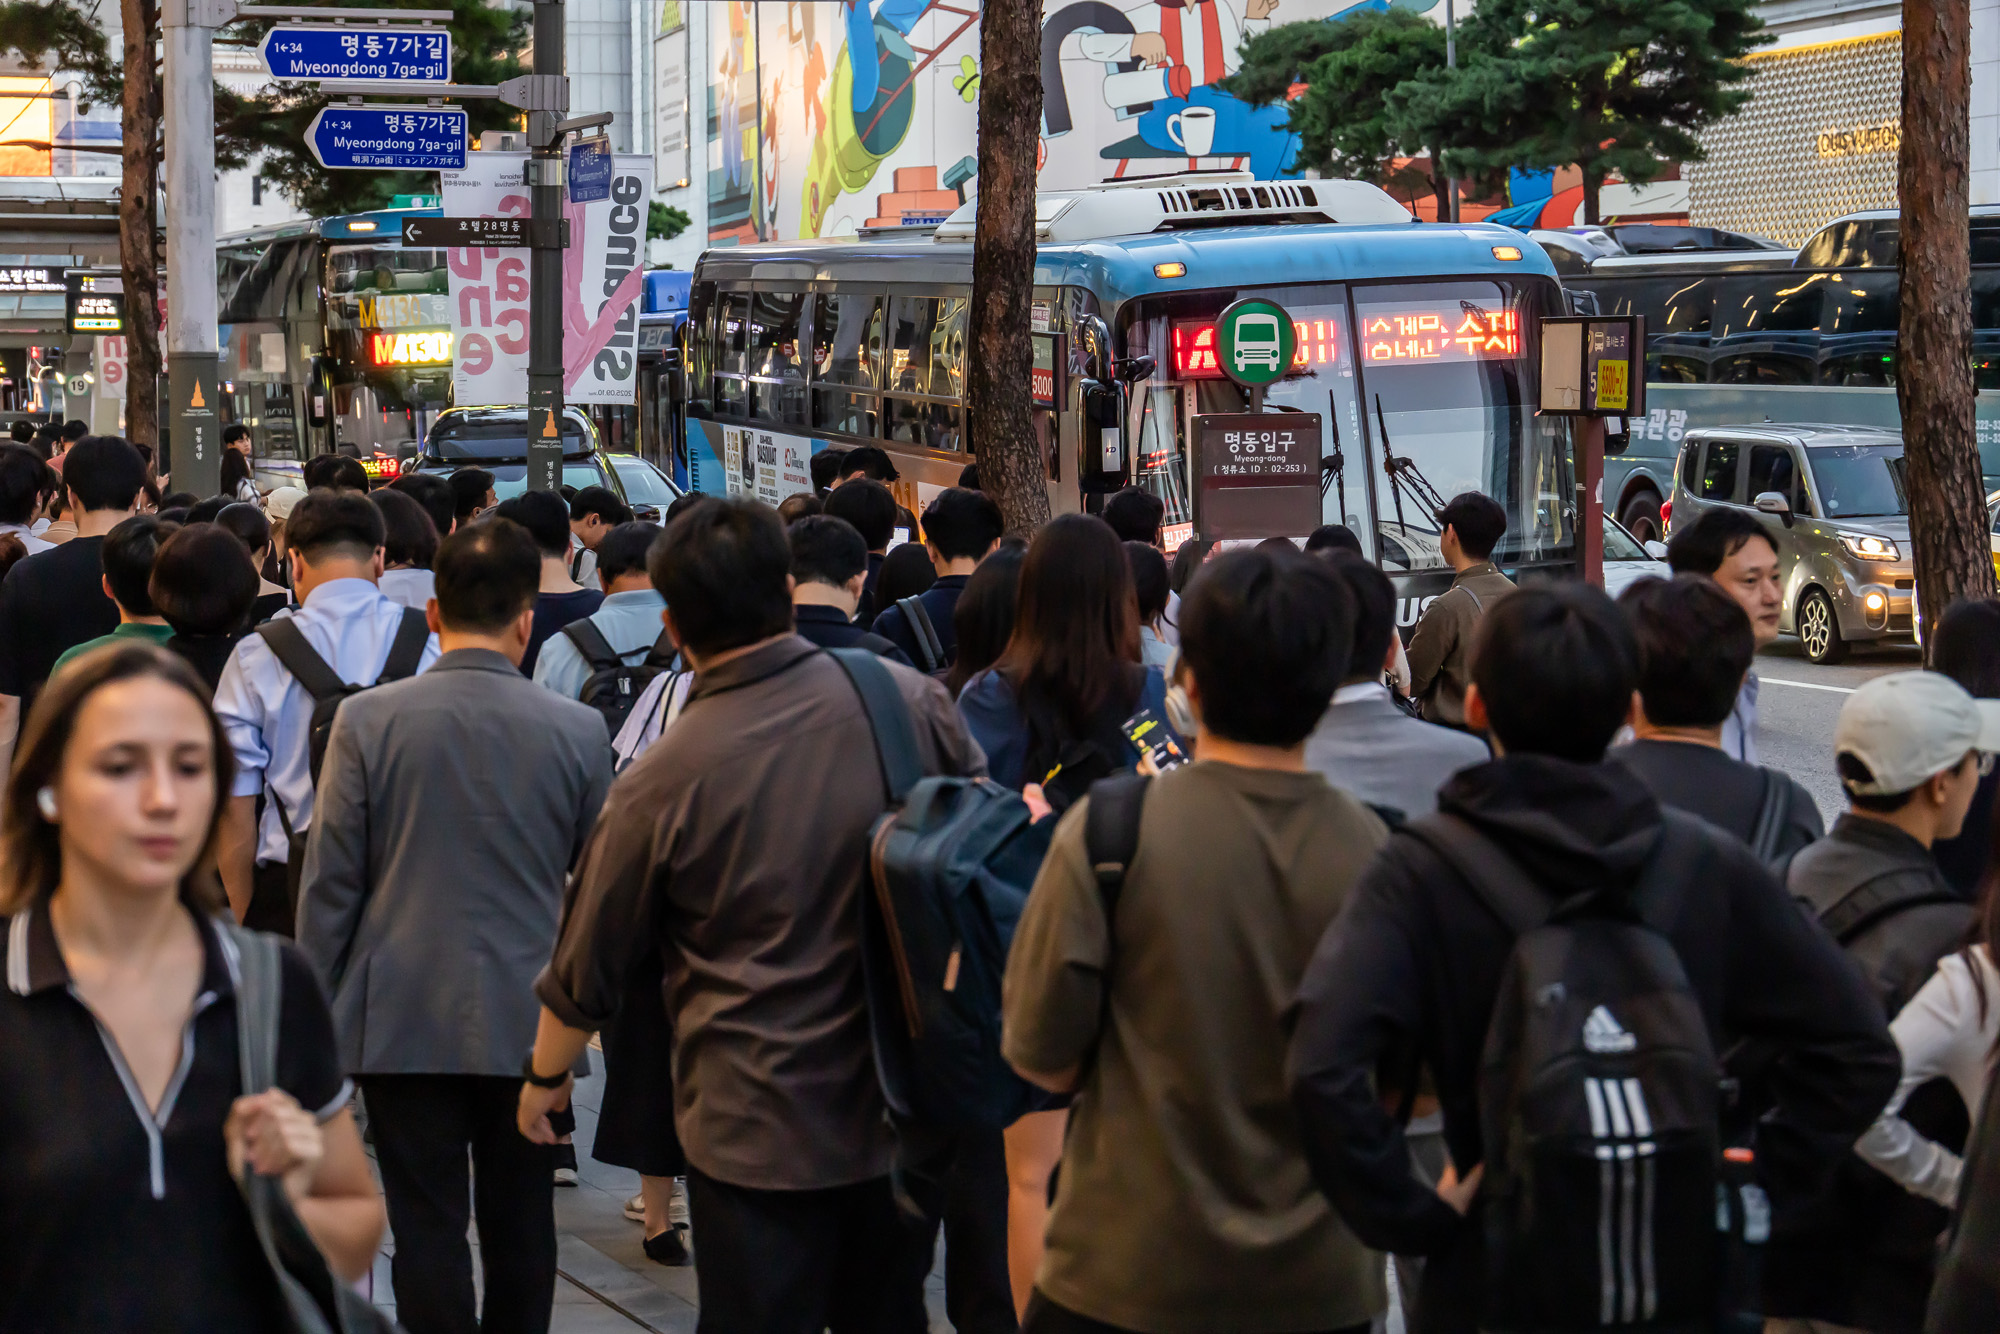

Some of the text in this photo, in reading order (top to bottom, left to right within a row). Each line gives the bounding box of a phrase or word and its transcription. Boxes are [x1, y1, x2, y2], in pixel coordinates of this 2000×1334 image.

[274, 42, 303, 53] 1 34
[341, 34, 443, 59] 명동7가길
[290, 59, 443, 78] Myeongdong 7ga-gil
[324, 120, 352, 130] 1 34
[384, 113, 461, 135] 명동7가길
[334, 136, 461, 152] Myeongdong 7ga-gil
[358, 295, 421, 329] M4130
[373, 332, 449, 365] M4130
[71, 380, 84, 391] 19
[1224, 431, 1296, 454] 명동입구
[1234, 453, 1286, 464] Myeong-dong
[1221, 464, 1247, 475] 정류소
[1250, 464, 1261, 474] ID
[1271, 464, 1300, 474] 02-253
